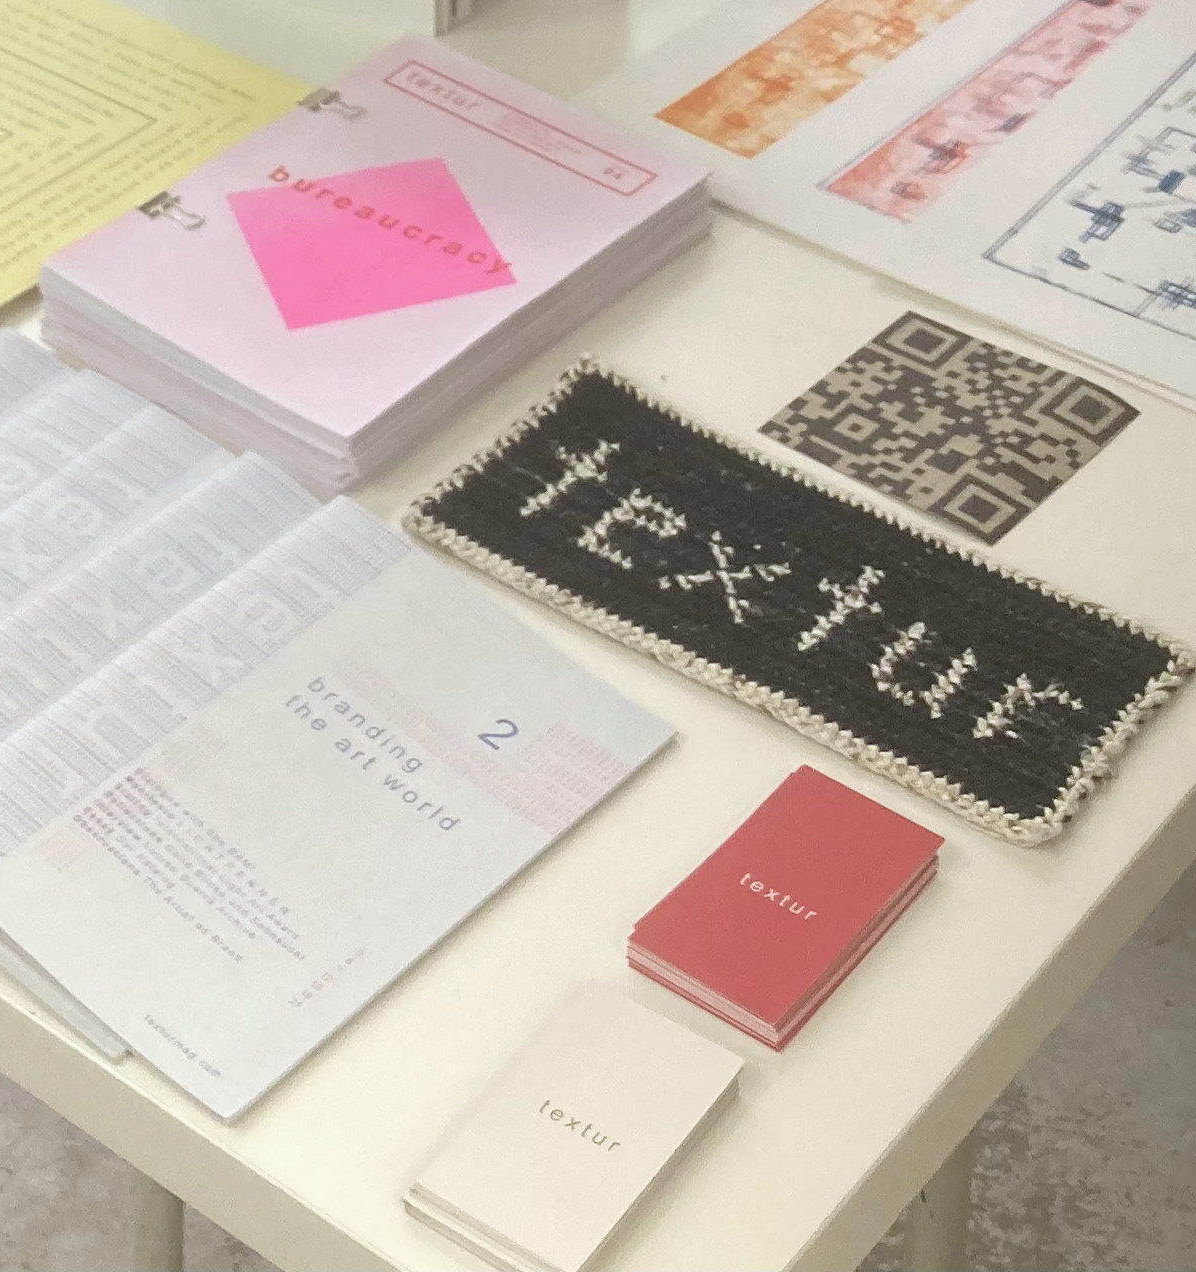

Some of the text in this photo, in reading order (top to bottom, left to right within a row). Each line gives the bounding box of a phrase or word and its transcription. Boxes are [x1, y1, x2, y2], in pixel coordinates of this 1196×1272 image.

[406, 71, 482, 110] textur
[268, 164, 513, 276] bureaucracy
[306, 676, 424, 775] branding
[477, 717, 520, 751] 2
[285, 693, 462, 832] the art world
[738, 870, 818, 922] textur
[539, 1098, 621, 1154] textur
